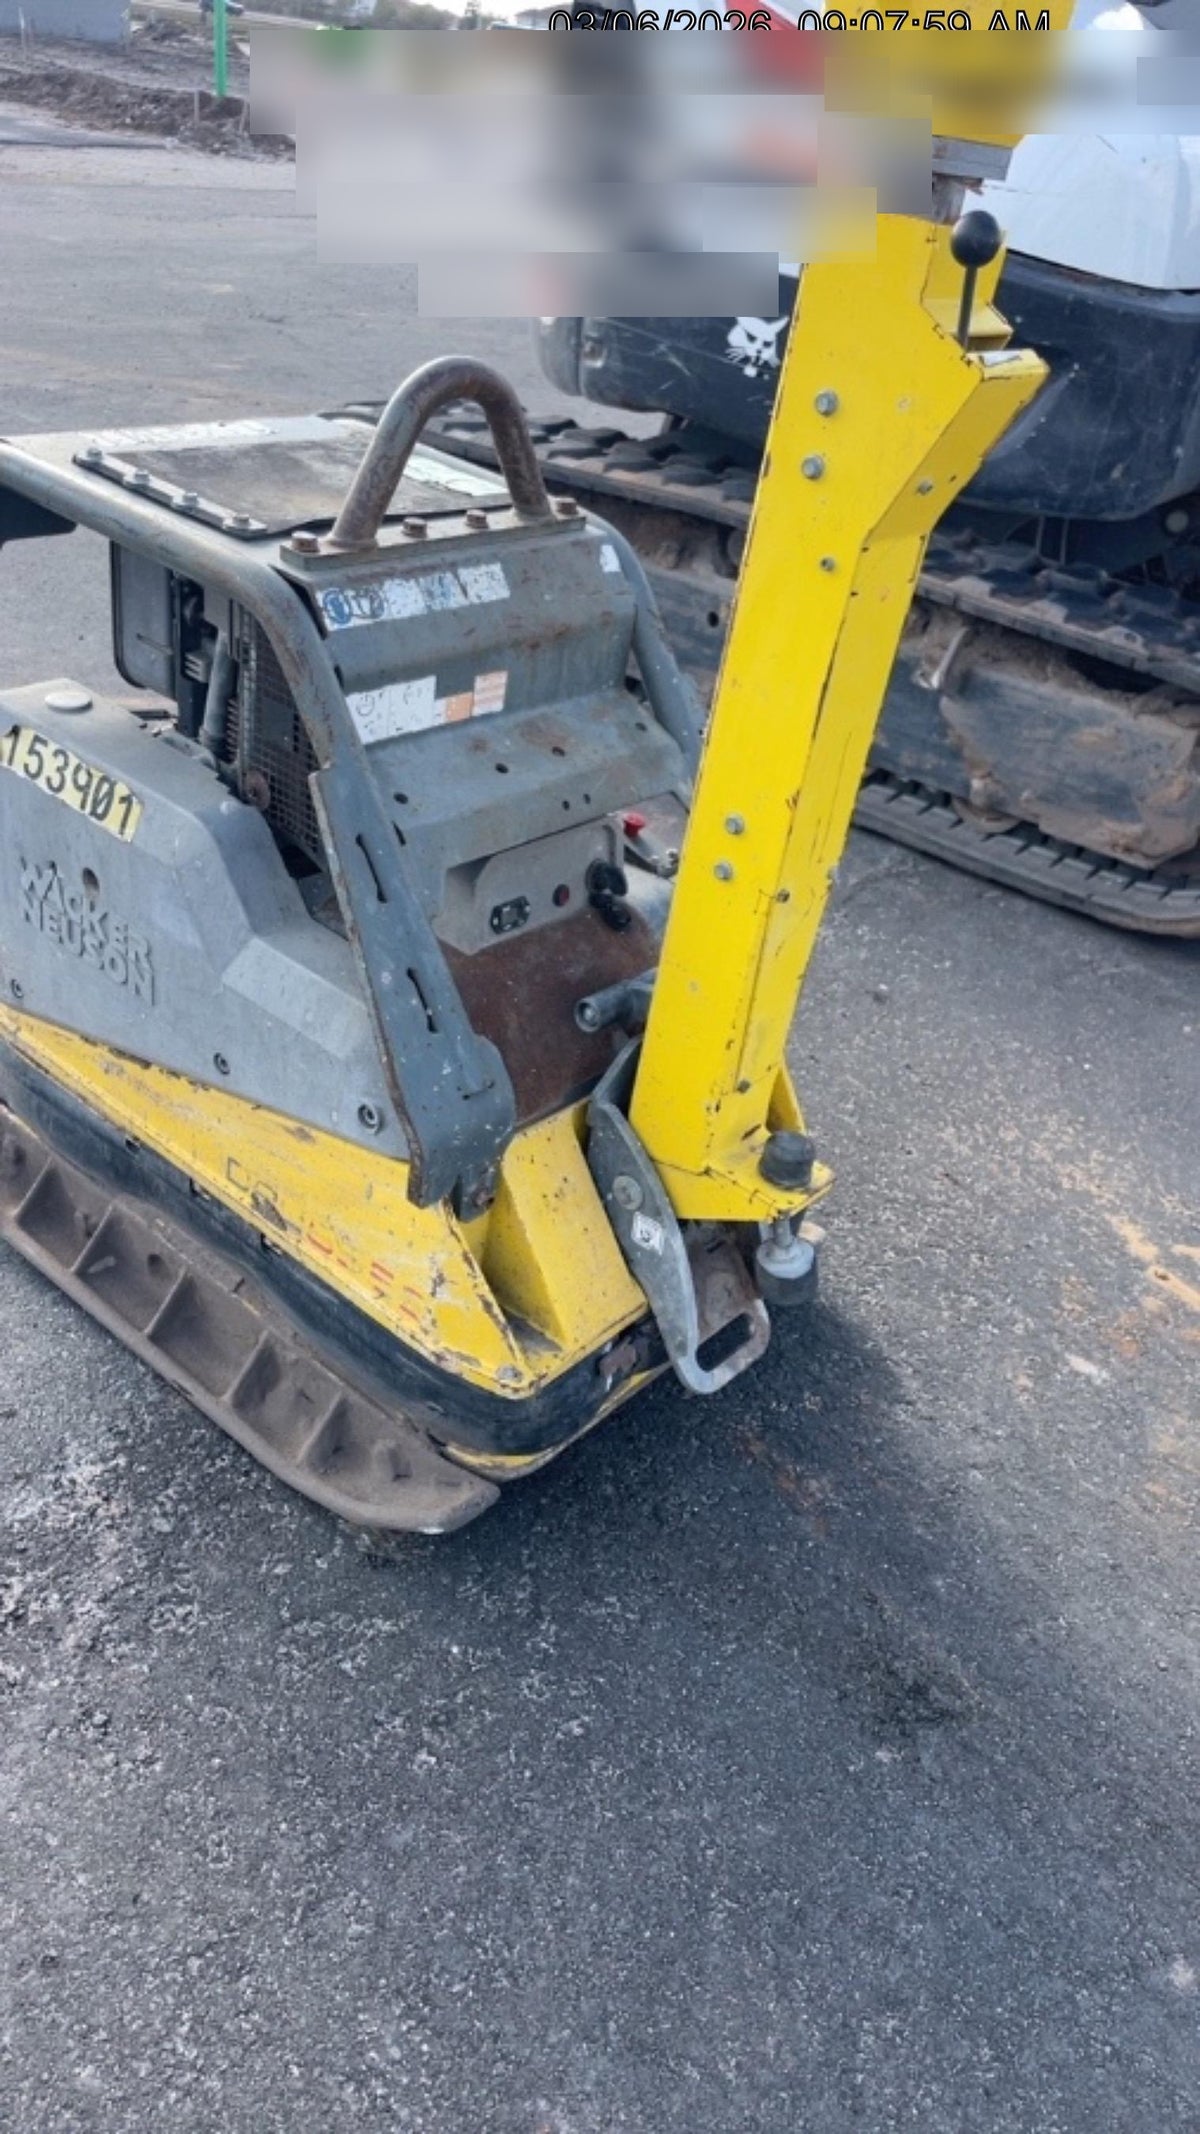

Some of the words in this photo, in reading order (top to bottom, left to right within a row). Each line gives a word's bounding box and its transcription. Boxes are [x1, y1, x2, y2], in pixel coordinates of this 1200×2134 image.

[3, 724, 134, 836] 153901
[20, 855, 153, 972] WACKER
[22, 889, 156, 1006] NEUSON
